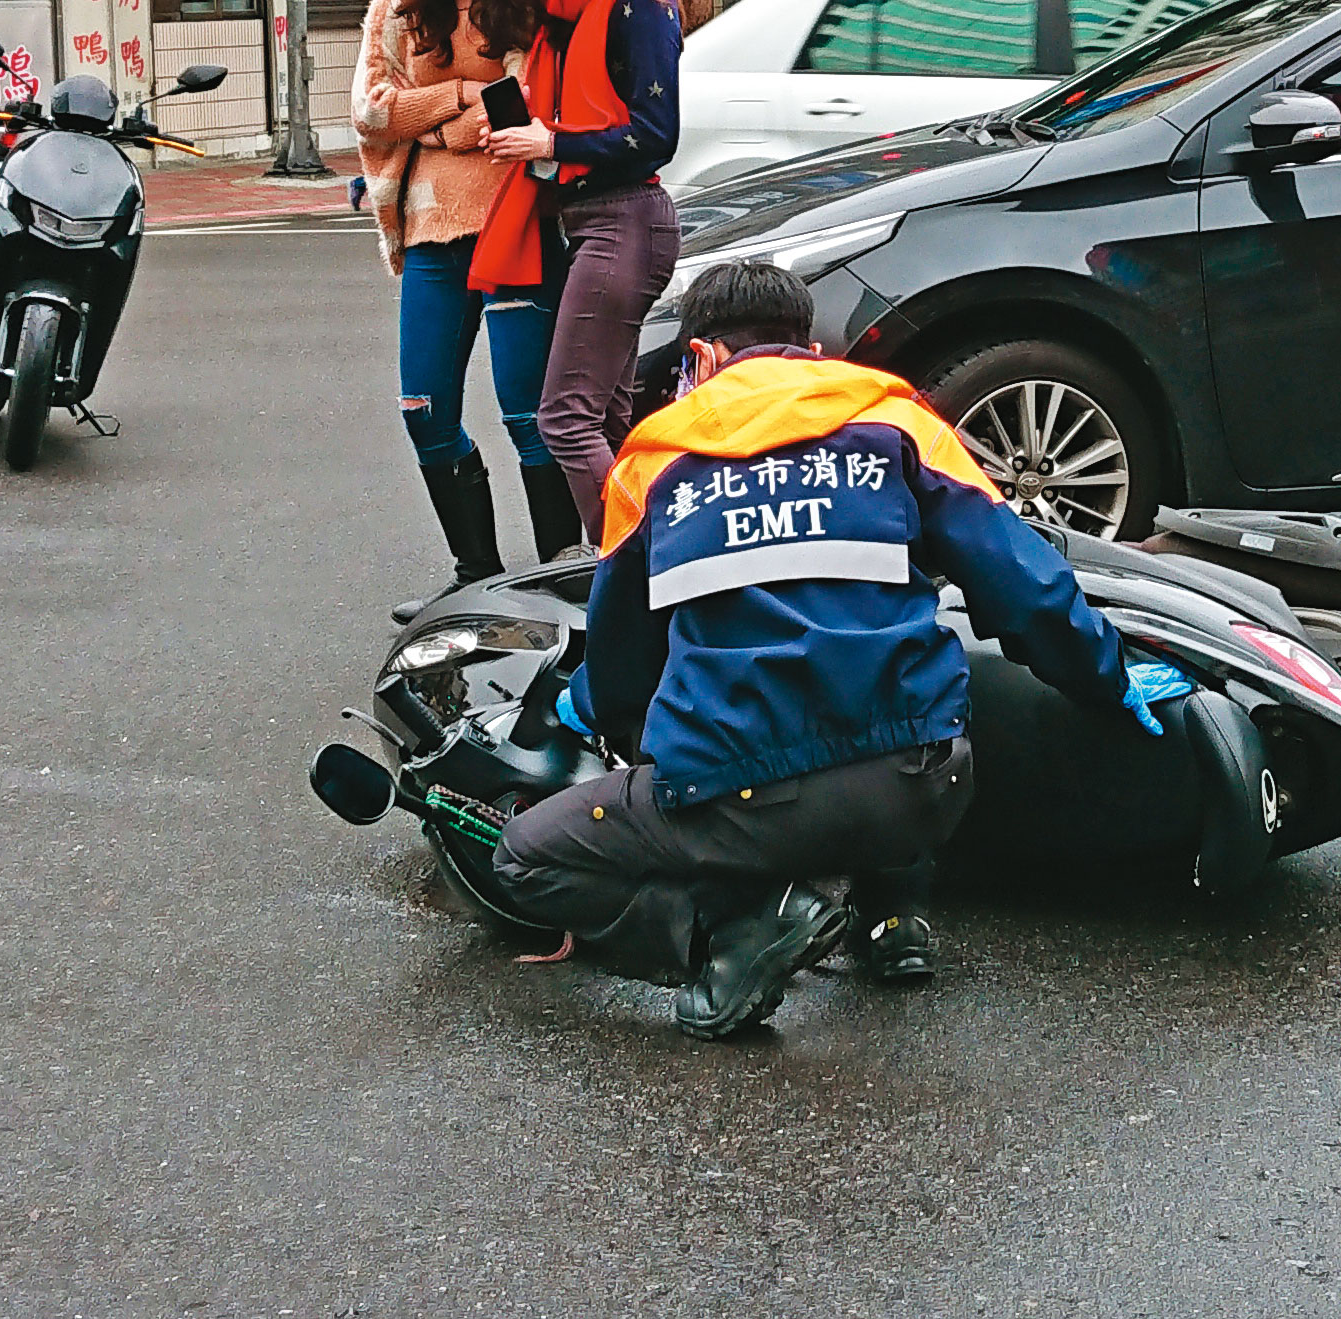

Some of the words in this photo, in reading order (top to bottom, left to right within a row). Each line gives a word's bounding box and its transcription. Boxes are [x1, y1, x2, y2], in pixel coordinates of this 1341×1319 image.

[665, 447, 891, 527] 臺北市消防
[721, 496, 833, 548] EMT
